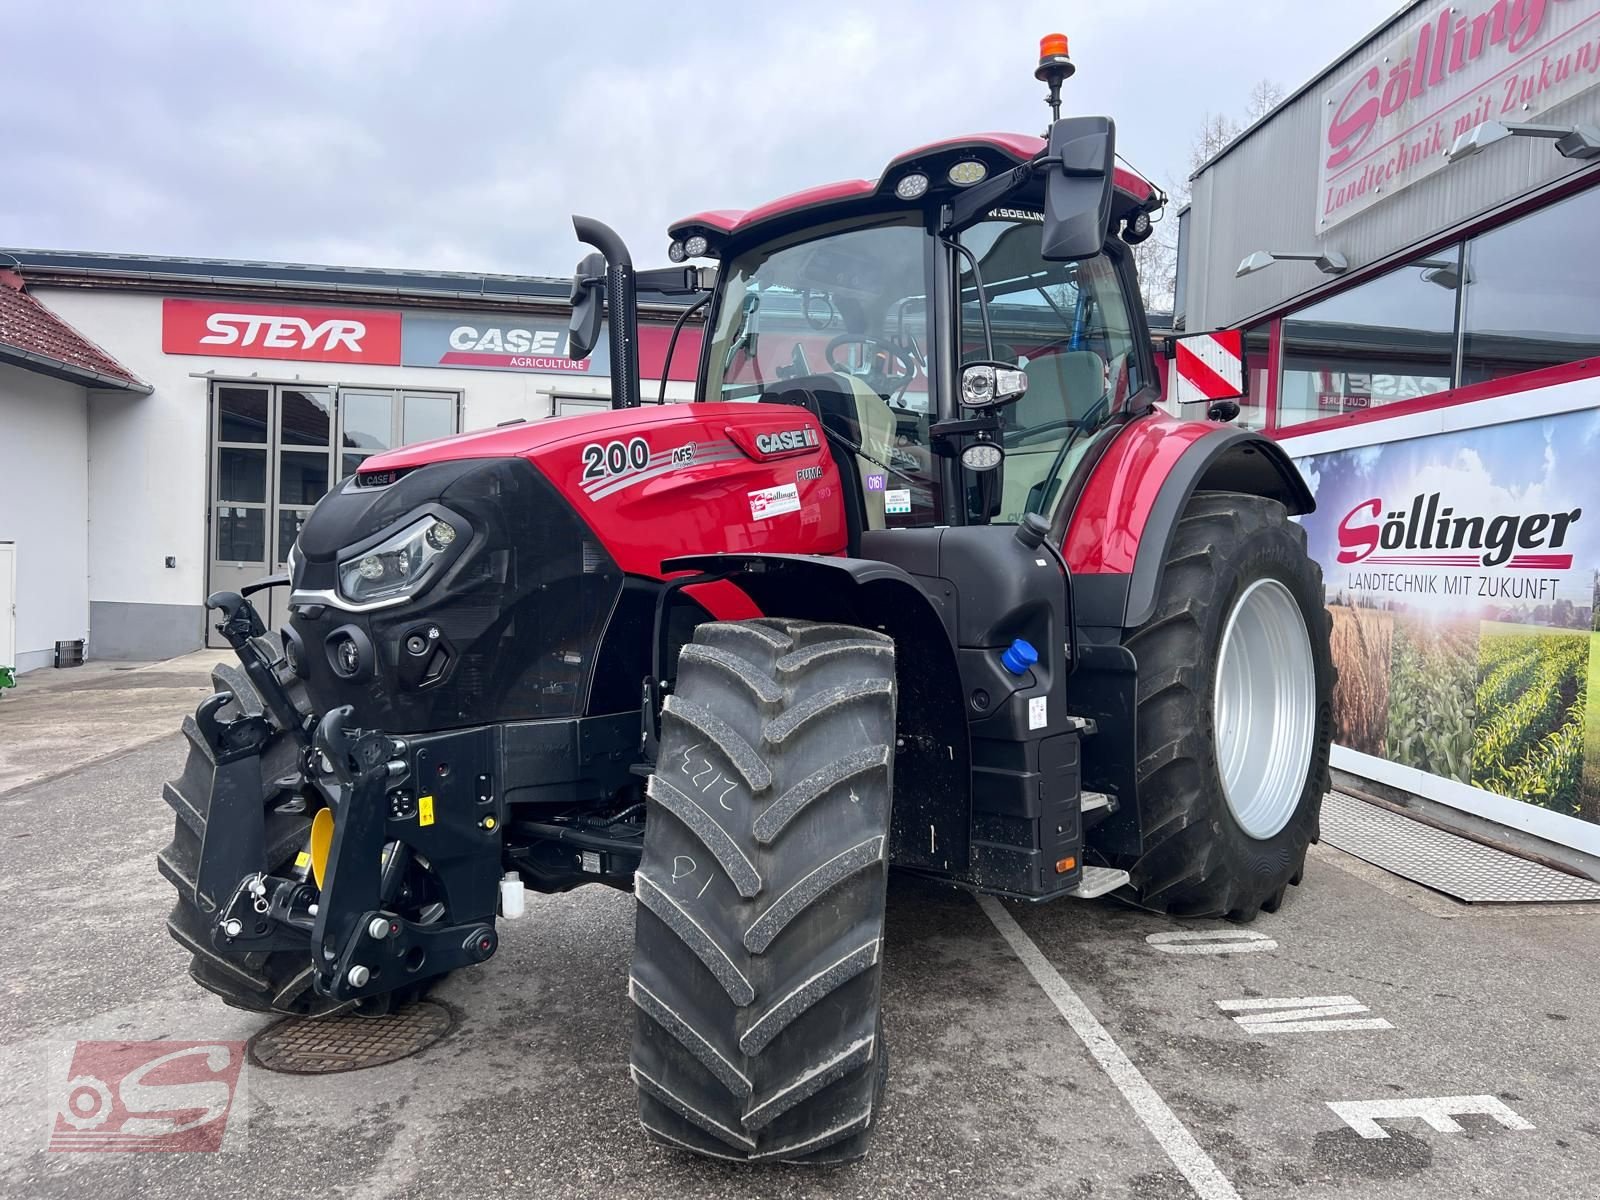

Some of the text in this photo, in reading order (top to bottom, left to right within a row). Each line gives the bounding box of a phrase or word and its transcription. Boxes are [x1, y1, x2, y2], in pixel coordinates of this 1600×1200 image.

[1324, 121, 1444, 215] Landtechnik
[200, 312, 367, 352] STEYR
[449, 326, 560, 354] CASE
[510, 357, 584, 370] AGRICULTURE
[672, 447, 692, 464] AFS
[756, 430, 804, 453] CASE
[582, 437, 650, 481] 200
[366, 474, 389, 485] CASE
[796, 466, 824, 481] PUMA
[1337, 492, 1582, 567] Söllinger
[1348, 572, 1560, 600] LANDTECHNIK MIT ZUKUNFT
